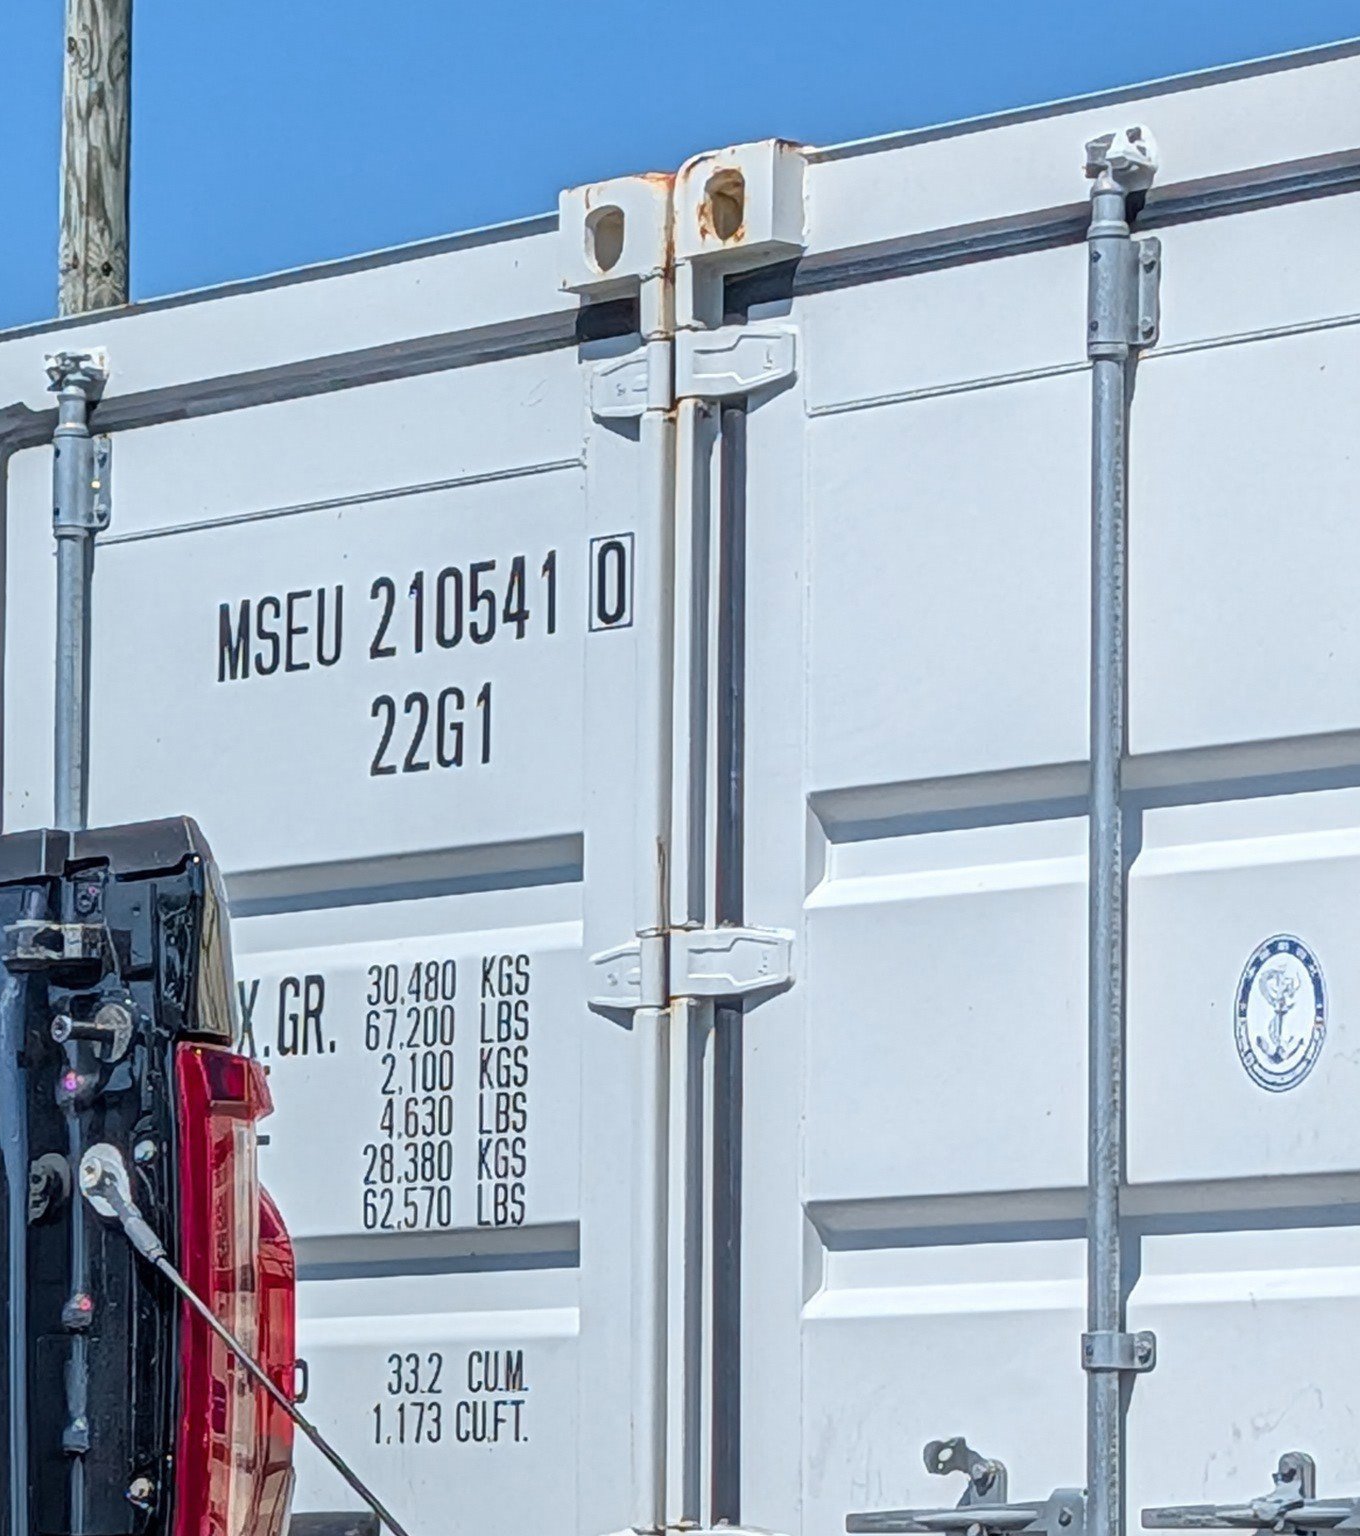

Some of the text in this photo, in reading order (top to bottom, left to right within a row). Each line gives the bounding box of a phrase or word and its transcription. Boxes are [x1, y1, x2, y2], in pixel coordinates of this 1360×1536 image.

[217, 540, 627, 683] MSEU 210541 0
[369, 681, 492, 777] 22G1
[366, 958, 457, 1006] 30,480
[480, 954, 530, 998] KGS
[365, 999, 529, 1051] 67,200 LBS
[381, 1045, 528, 1096] 2,100 KGS
[379, 1091, 527, 1140] 4,630 LBS
[362, 1136, 527, 1185] 28,380 KGS
[362, 1182, 526, 1230] 62,570 LBS
[387, 1352, 443, 1395] 33.2
[372, 1401, 442, 1445] 1,173
